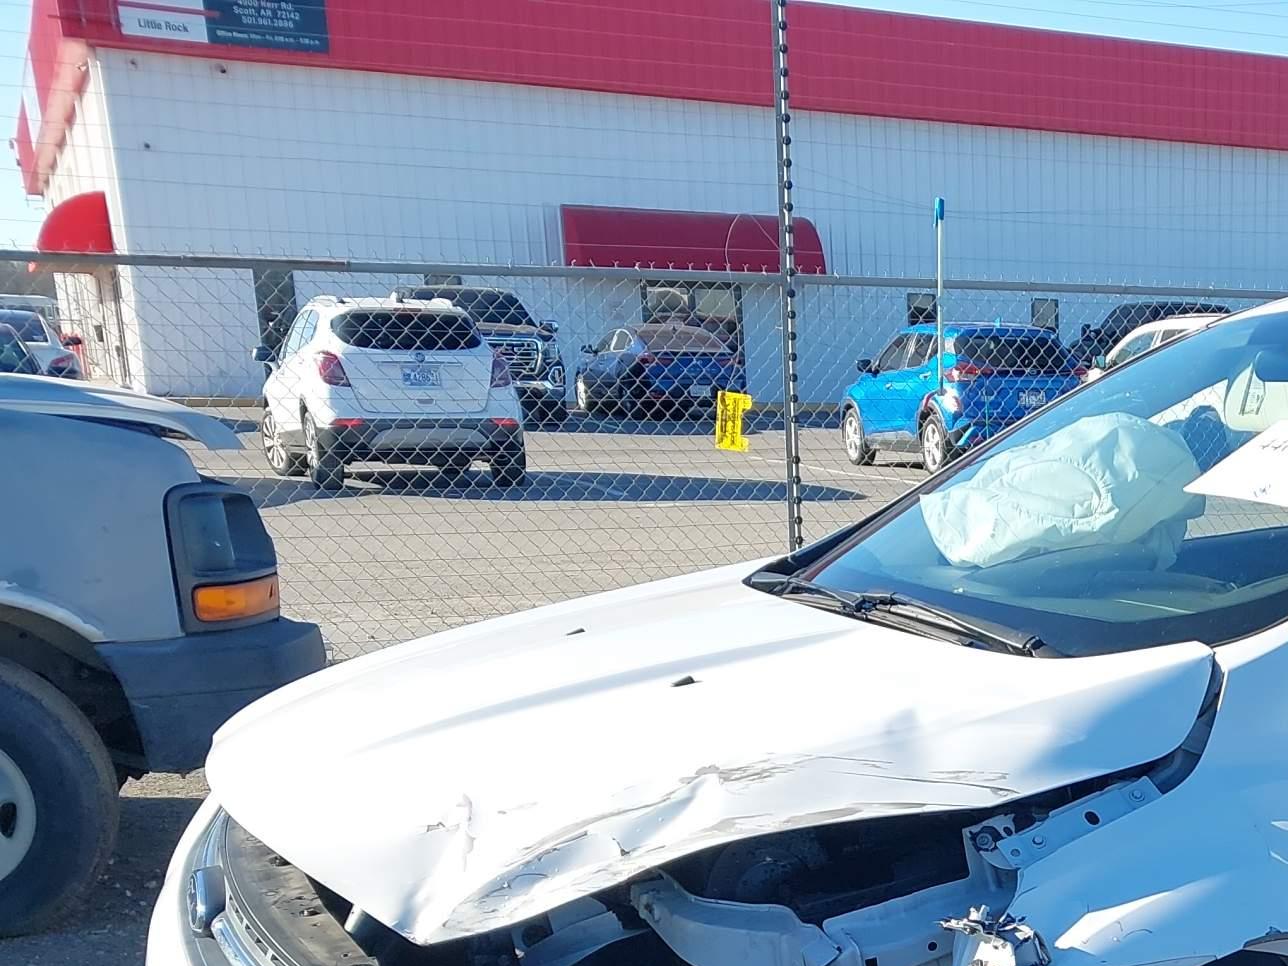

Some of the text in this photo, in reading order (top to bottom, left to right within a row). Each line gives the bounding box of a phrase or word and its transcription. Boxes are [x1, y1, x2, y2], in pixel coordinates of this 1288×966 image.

[260, 8, 272, 17] AR
[137, 18, 189, 32] Little Rock
